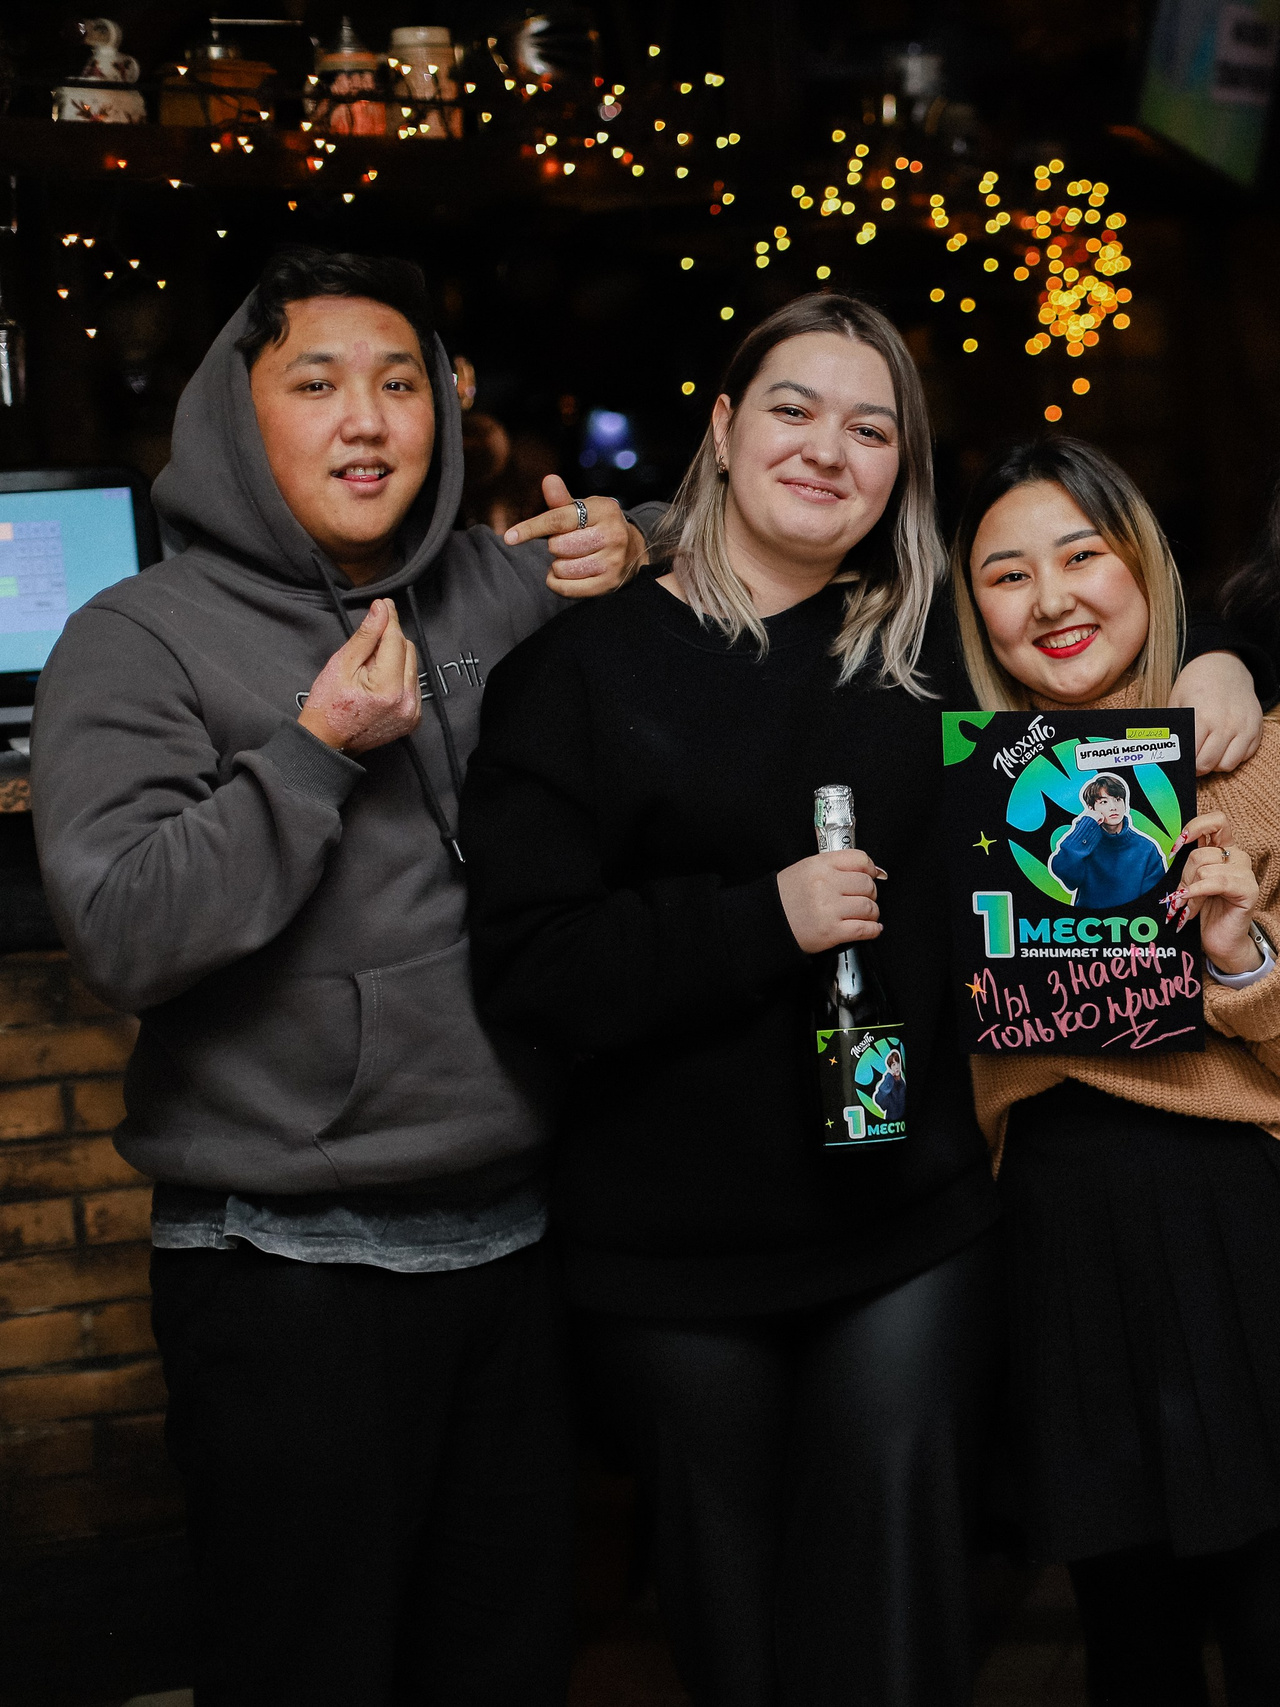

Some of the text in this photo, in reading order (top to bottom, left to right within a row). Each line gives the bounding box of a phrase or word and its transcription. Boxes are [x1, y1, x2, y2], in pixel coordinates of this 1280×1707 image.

[992, 714, 1056, 779] Мохито
[1080, 741, 1176, 760] УГАДАЙ МЕЛОДИЮ:
[972, 891, 1159, 959] 1 МЕСТО
[1020, 947, 1177, 960] ЗАНИМАЕТ КОМАНДА
[843, 1105, 906, 1139] 1 МЕСТО
